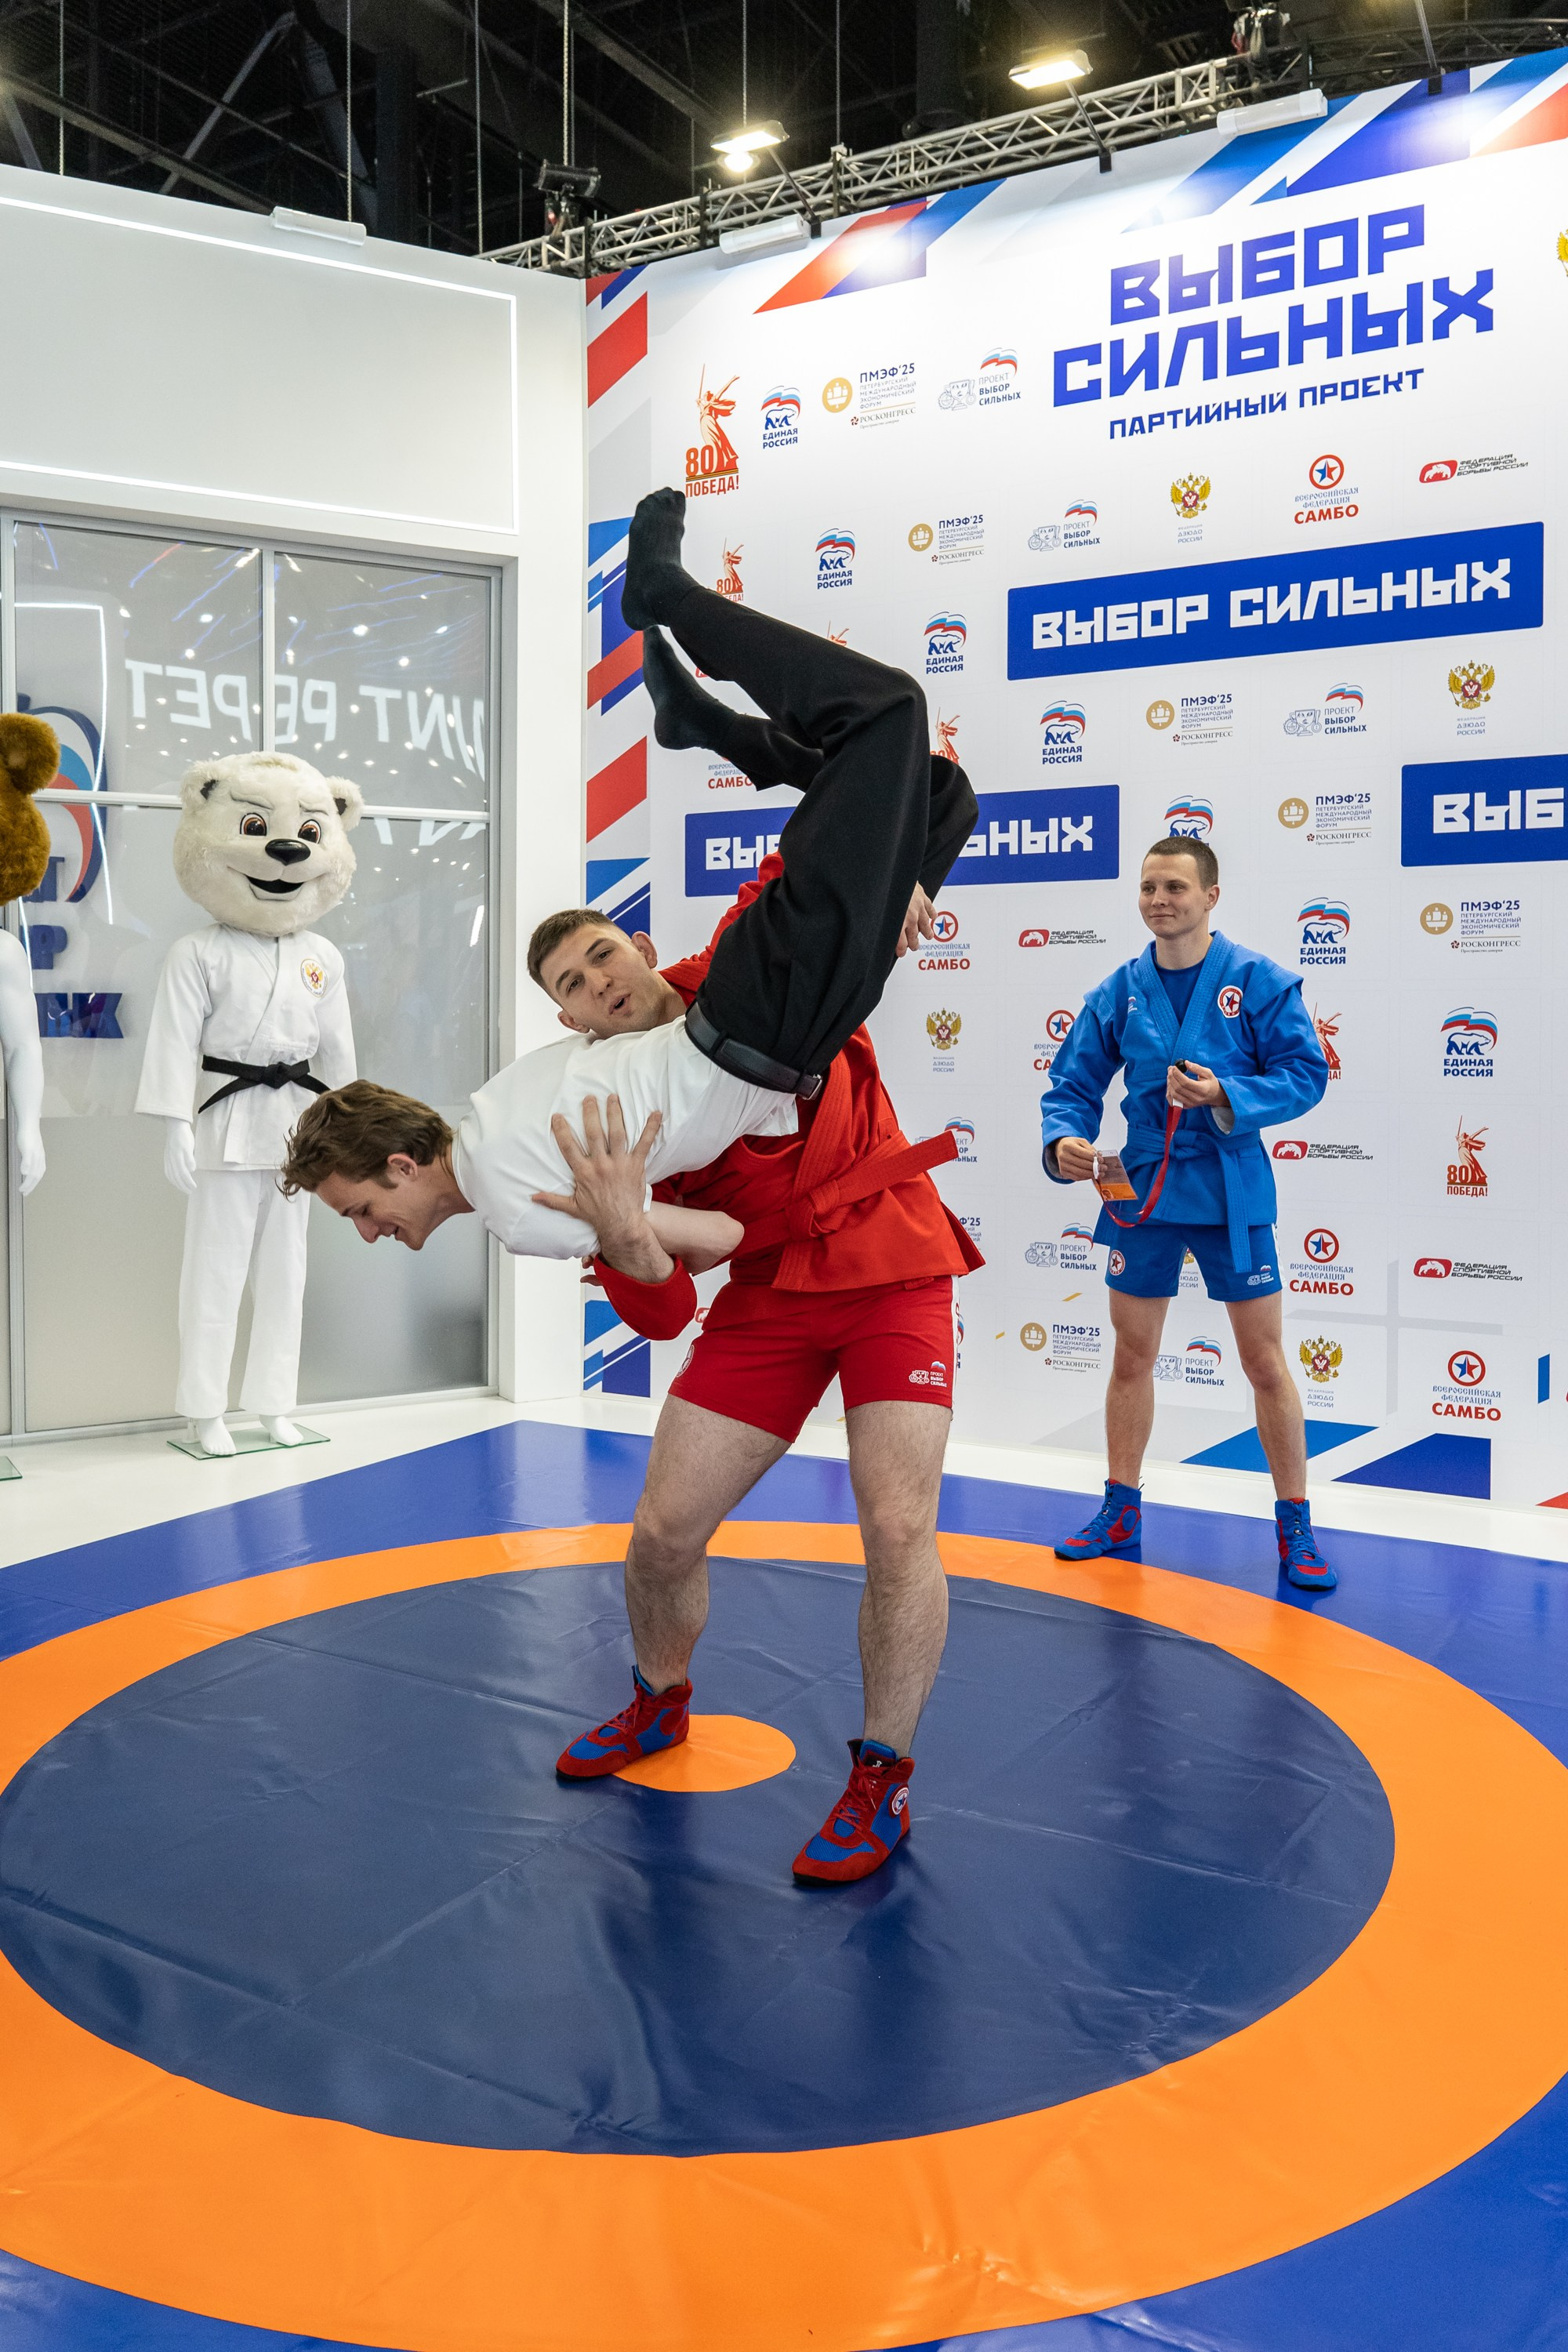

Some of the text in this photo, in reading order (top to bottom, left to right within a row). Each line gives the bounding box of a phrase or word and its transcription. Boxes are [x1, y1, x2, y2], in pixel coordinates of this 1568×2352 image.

[1111, 204, 1425, 325] ВЫБОР
[1054, 268, 1494, 407] СИЛЬНЫХ
[978, 372, 1009, 385] ПРОЕКТ
[979, 383, 1010, 395] ВЫБОР
[979, 391, 1021, 406] СИЛЬНЫХ
[1109, 368, 1425, 439] ПАРТИЙНЫЙ ПРОЕКТ
[860, 407, 916, 423] РОСКОНГРЕСС
[763, 428, 798, 440] ЕДИНАЯ
[763, 437, 798, 449] РОССИЯ
[686, 445, 714, 477] 80
[1458, 458, 1517, 471] СПОРТИВНОЙ
[1460, 454, 1513, 465] ФЕДЕРАЦИЯ
[1457, 462, 1529, 477] БОРЬБЫ РОССИИ
[686, 475, 739, 498] ПОБЕДА!
[1302, 496, 1350, 509] ФЕДЕРАЦИЯ
[1294, 504, 1359, 524] САМБО
[939, 524, 978, 535] ПЕТЕРБУРГСКИЙ
[1063, 521, 1090, 531] ПРОЕКТ
[939, 529, 984, 539] МЕЖДУНАРОДНЫЙ
[1064, 530, 1091, 539] ВЫБОР
[939, 535, 983, 545] ЭКОНОМИЧЕСКИЙ
[1064, 537, 1100, 548] СИЛЬНЫХ
[939, 550, 984, 561] РОСКОНГРЕСС
[818, 570, 852, 581] ЕДИНАЯ
[717, 578, 731, 594] 80
[818, 578, 852, 590] РОССИЯ
[1033, 558, 1510, 649] ВЫБОР СИЛЬНЫХ
[926, 655, 964, 666] ЕДИНАЯ
[926, 664, 964, 674] РОССИЯ
[1181, 710, 1233, 718] МЕЖДУНАРОДНЫЙ
[1324, 706, 1355, 715] ПРОЕКТ
[1325, 716, 1356, 724] ВЫБОР
[1325, 724, 1367, 734] СИЛЬНЫХ
[1181, 731, 1233, 741] РОСКОНГРЕСС
[1042, 746, 1082, 756] ЕДИНАЯ
[1042, 755, 1082, 764] РОССИЯ
[1300, 947, 1346, 956] ЕДИНАЯ
[918, 958, 970, 971] САМБО
[1300, 956, 1346, 965] РОССИЯ
[1444, 1058, 1493, 1067] ЕДИНАЯ
[1447, 1165, 1469, 1183] 80
[1447, 1186, 1488, 1197] ПОБЕДА!
[1060, 1262, 1097, 1271] СИЛЬНЫХ
[1290, 1263, 1353, 1273] ВСЕРОССИЙСКАЯ
[1298, 1271, 1345, 1281] ФЕДЕРАЦИЯ
[1290, 1279, 1354, 1296] САМБО
[1053, 1339, 1101, 1348] МЕЖДУНАРОДНЫЙ
[1053, 1359, 1101, 1370] РОСКОНГРЕСС
[1185, 1358, 1214, 1367] ПРОЕКТ
[1185, 1376, 1225, 1386] СИЛЬНЫХ
[1432, 1385, 1501, 1398] ВСЕРОССИЙСКАЯ
[1441, 1394, 1492, 1406] ФЕДЕРАЦИЯ
[1432, 1403, 1501, 1421] САМБО
